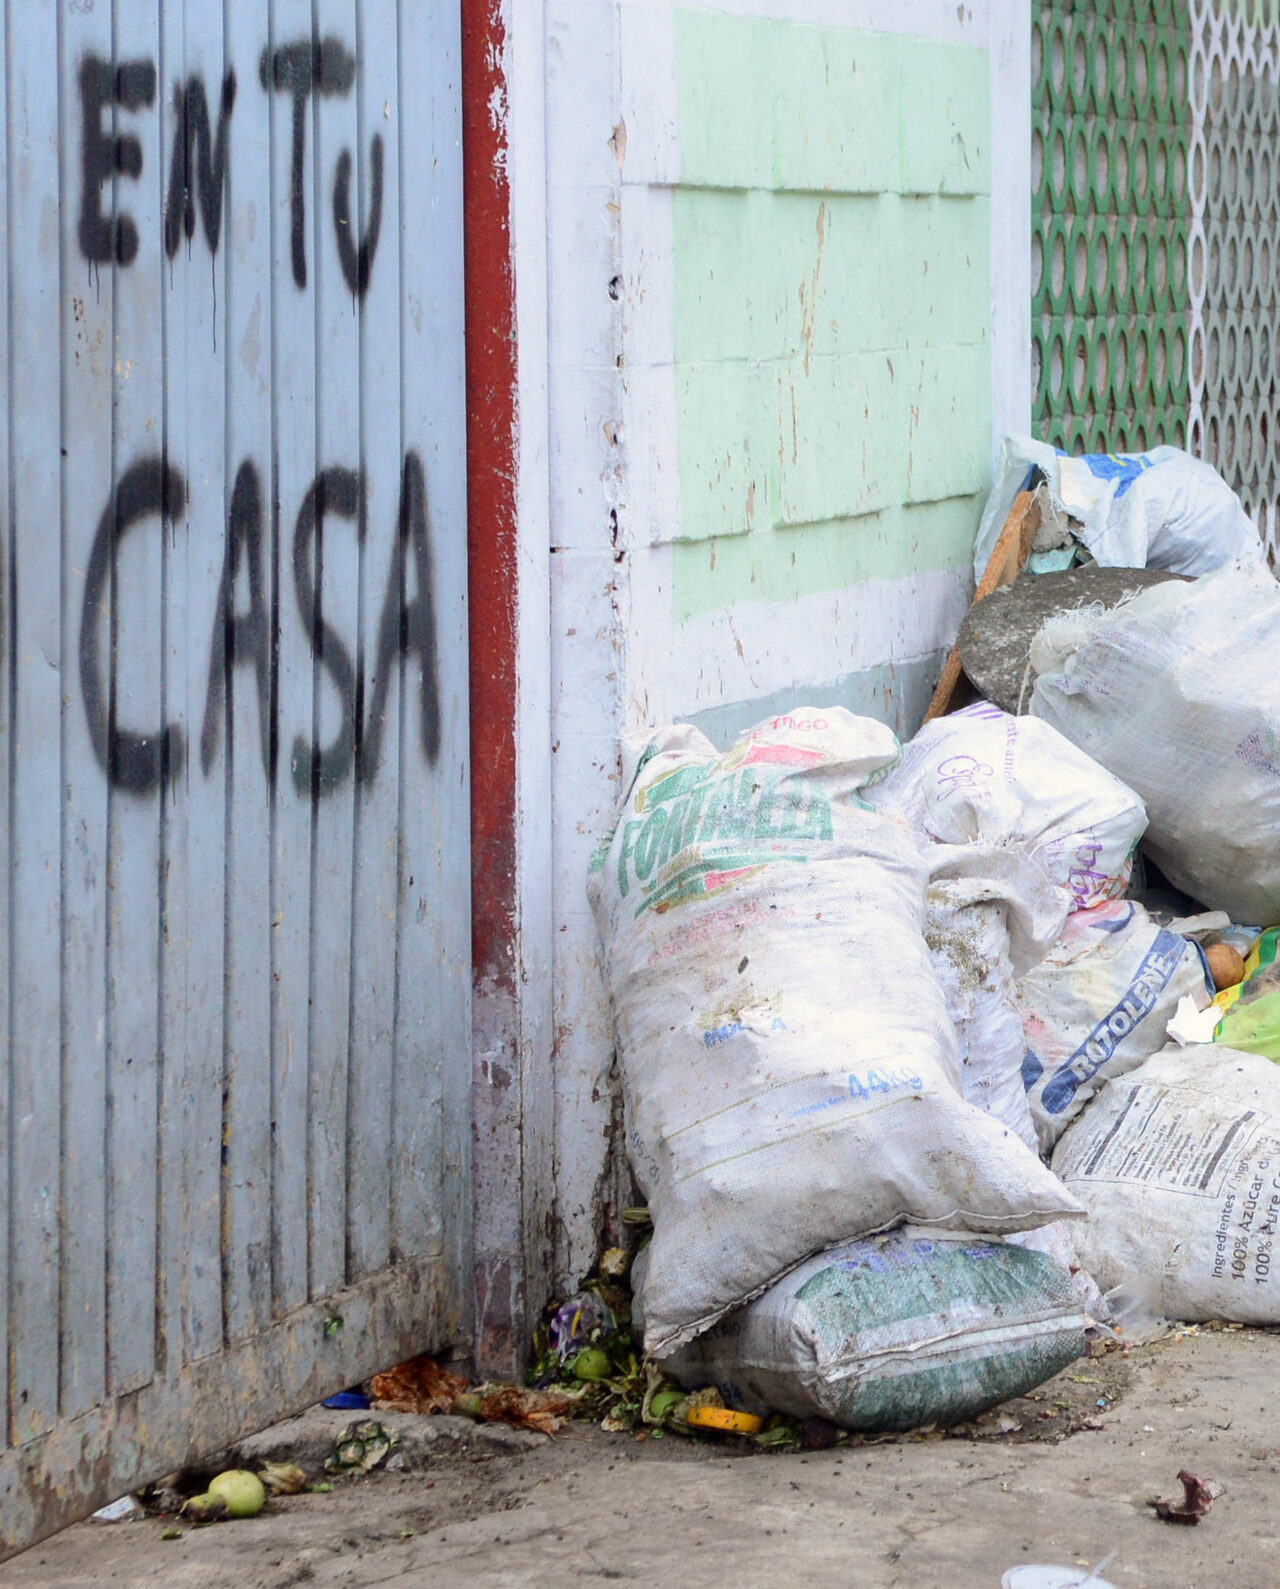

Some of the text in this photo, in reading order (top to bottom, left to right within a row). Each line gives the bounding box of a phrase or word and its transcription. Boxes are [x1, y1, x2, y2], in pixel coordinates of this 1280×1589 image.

[77, 36, 384, 297] EN TU
[78, 450, 442, 796] CASA
[1069, 952, 1173, 1081] ROTOLENE
[1211, 1193, 1237, 1278] Ingredientes
[1239, 1174, 1264, 1232] Azúcar
[1231, 1236, 1249, 1281] 100%
[1254, 1240, 1273, 1285] 100%
